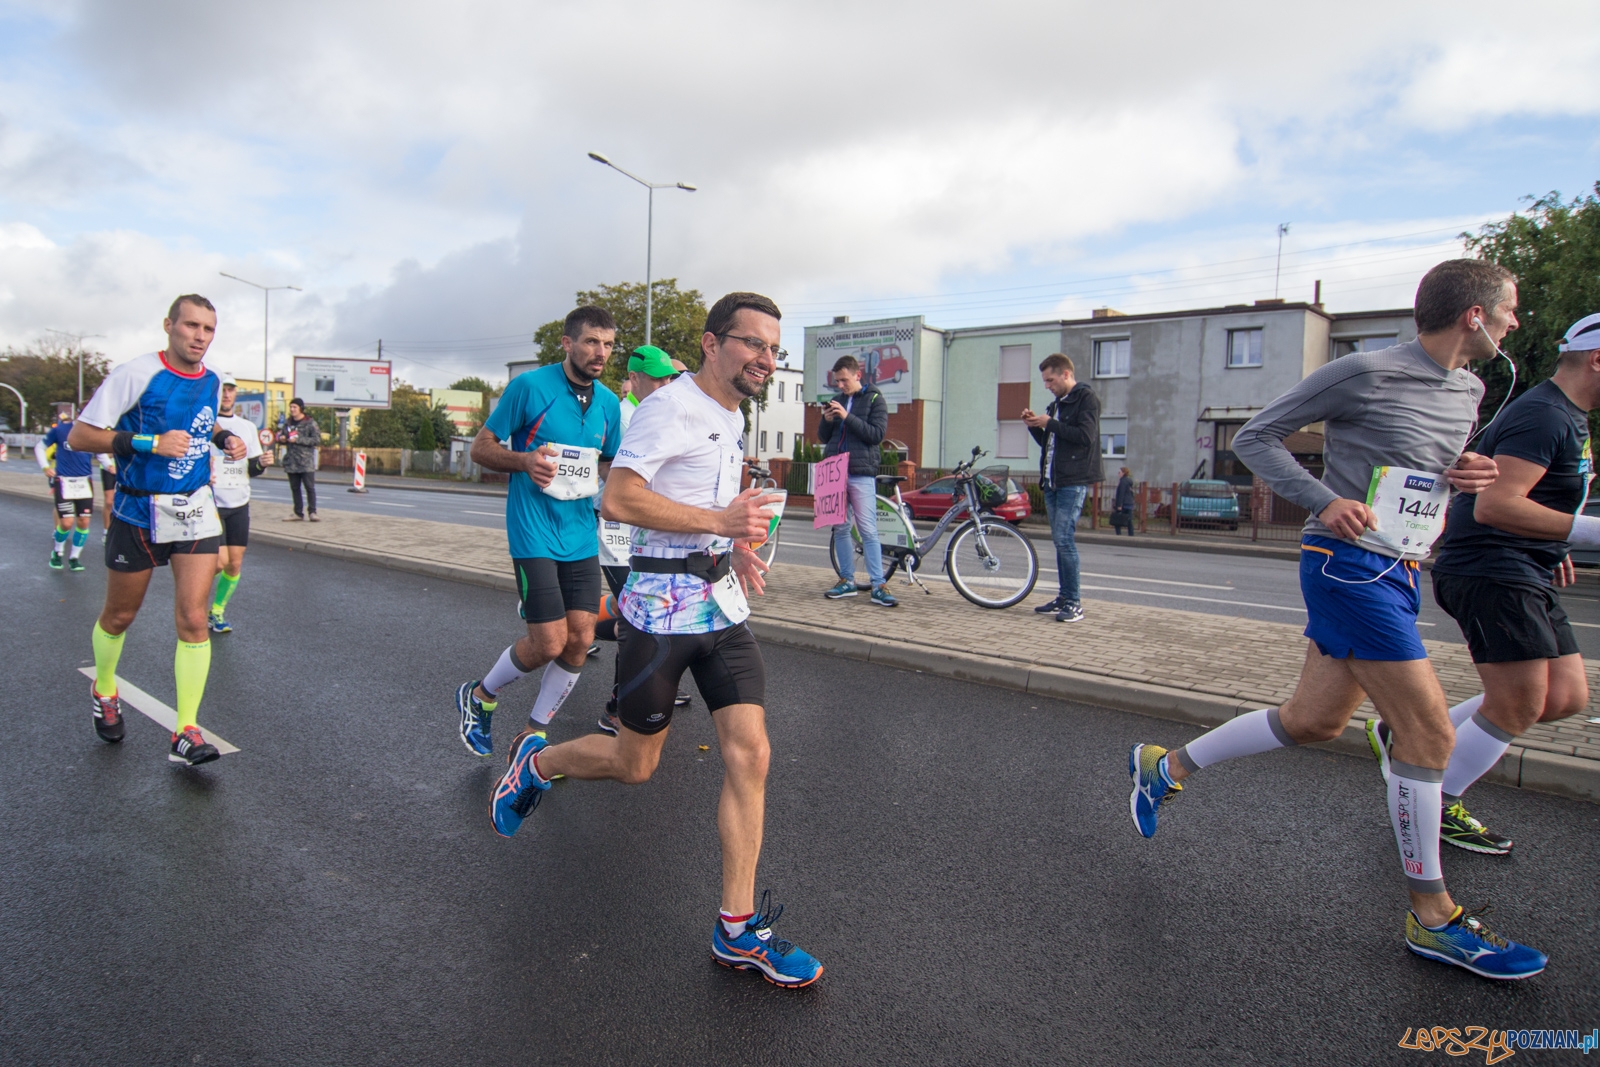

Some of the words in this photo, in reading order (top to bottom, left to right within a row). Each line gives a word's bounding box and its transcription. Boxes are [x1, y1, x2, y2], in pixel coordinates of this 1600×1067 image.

[708, 433, 720, 441] 4F
[1196, 436, 1213, 449] 12
[223, 467, 243, 475] 2816
[557, 464, 591, 478] 5949
[175, 506, 204, 521] 945
[1398, 497, 1440, 519] 1444
